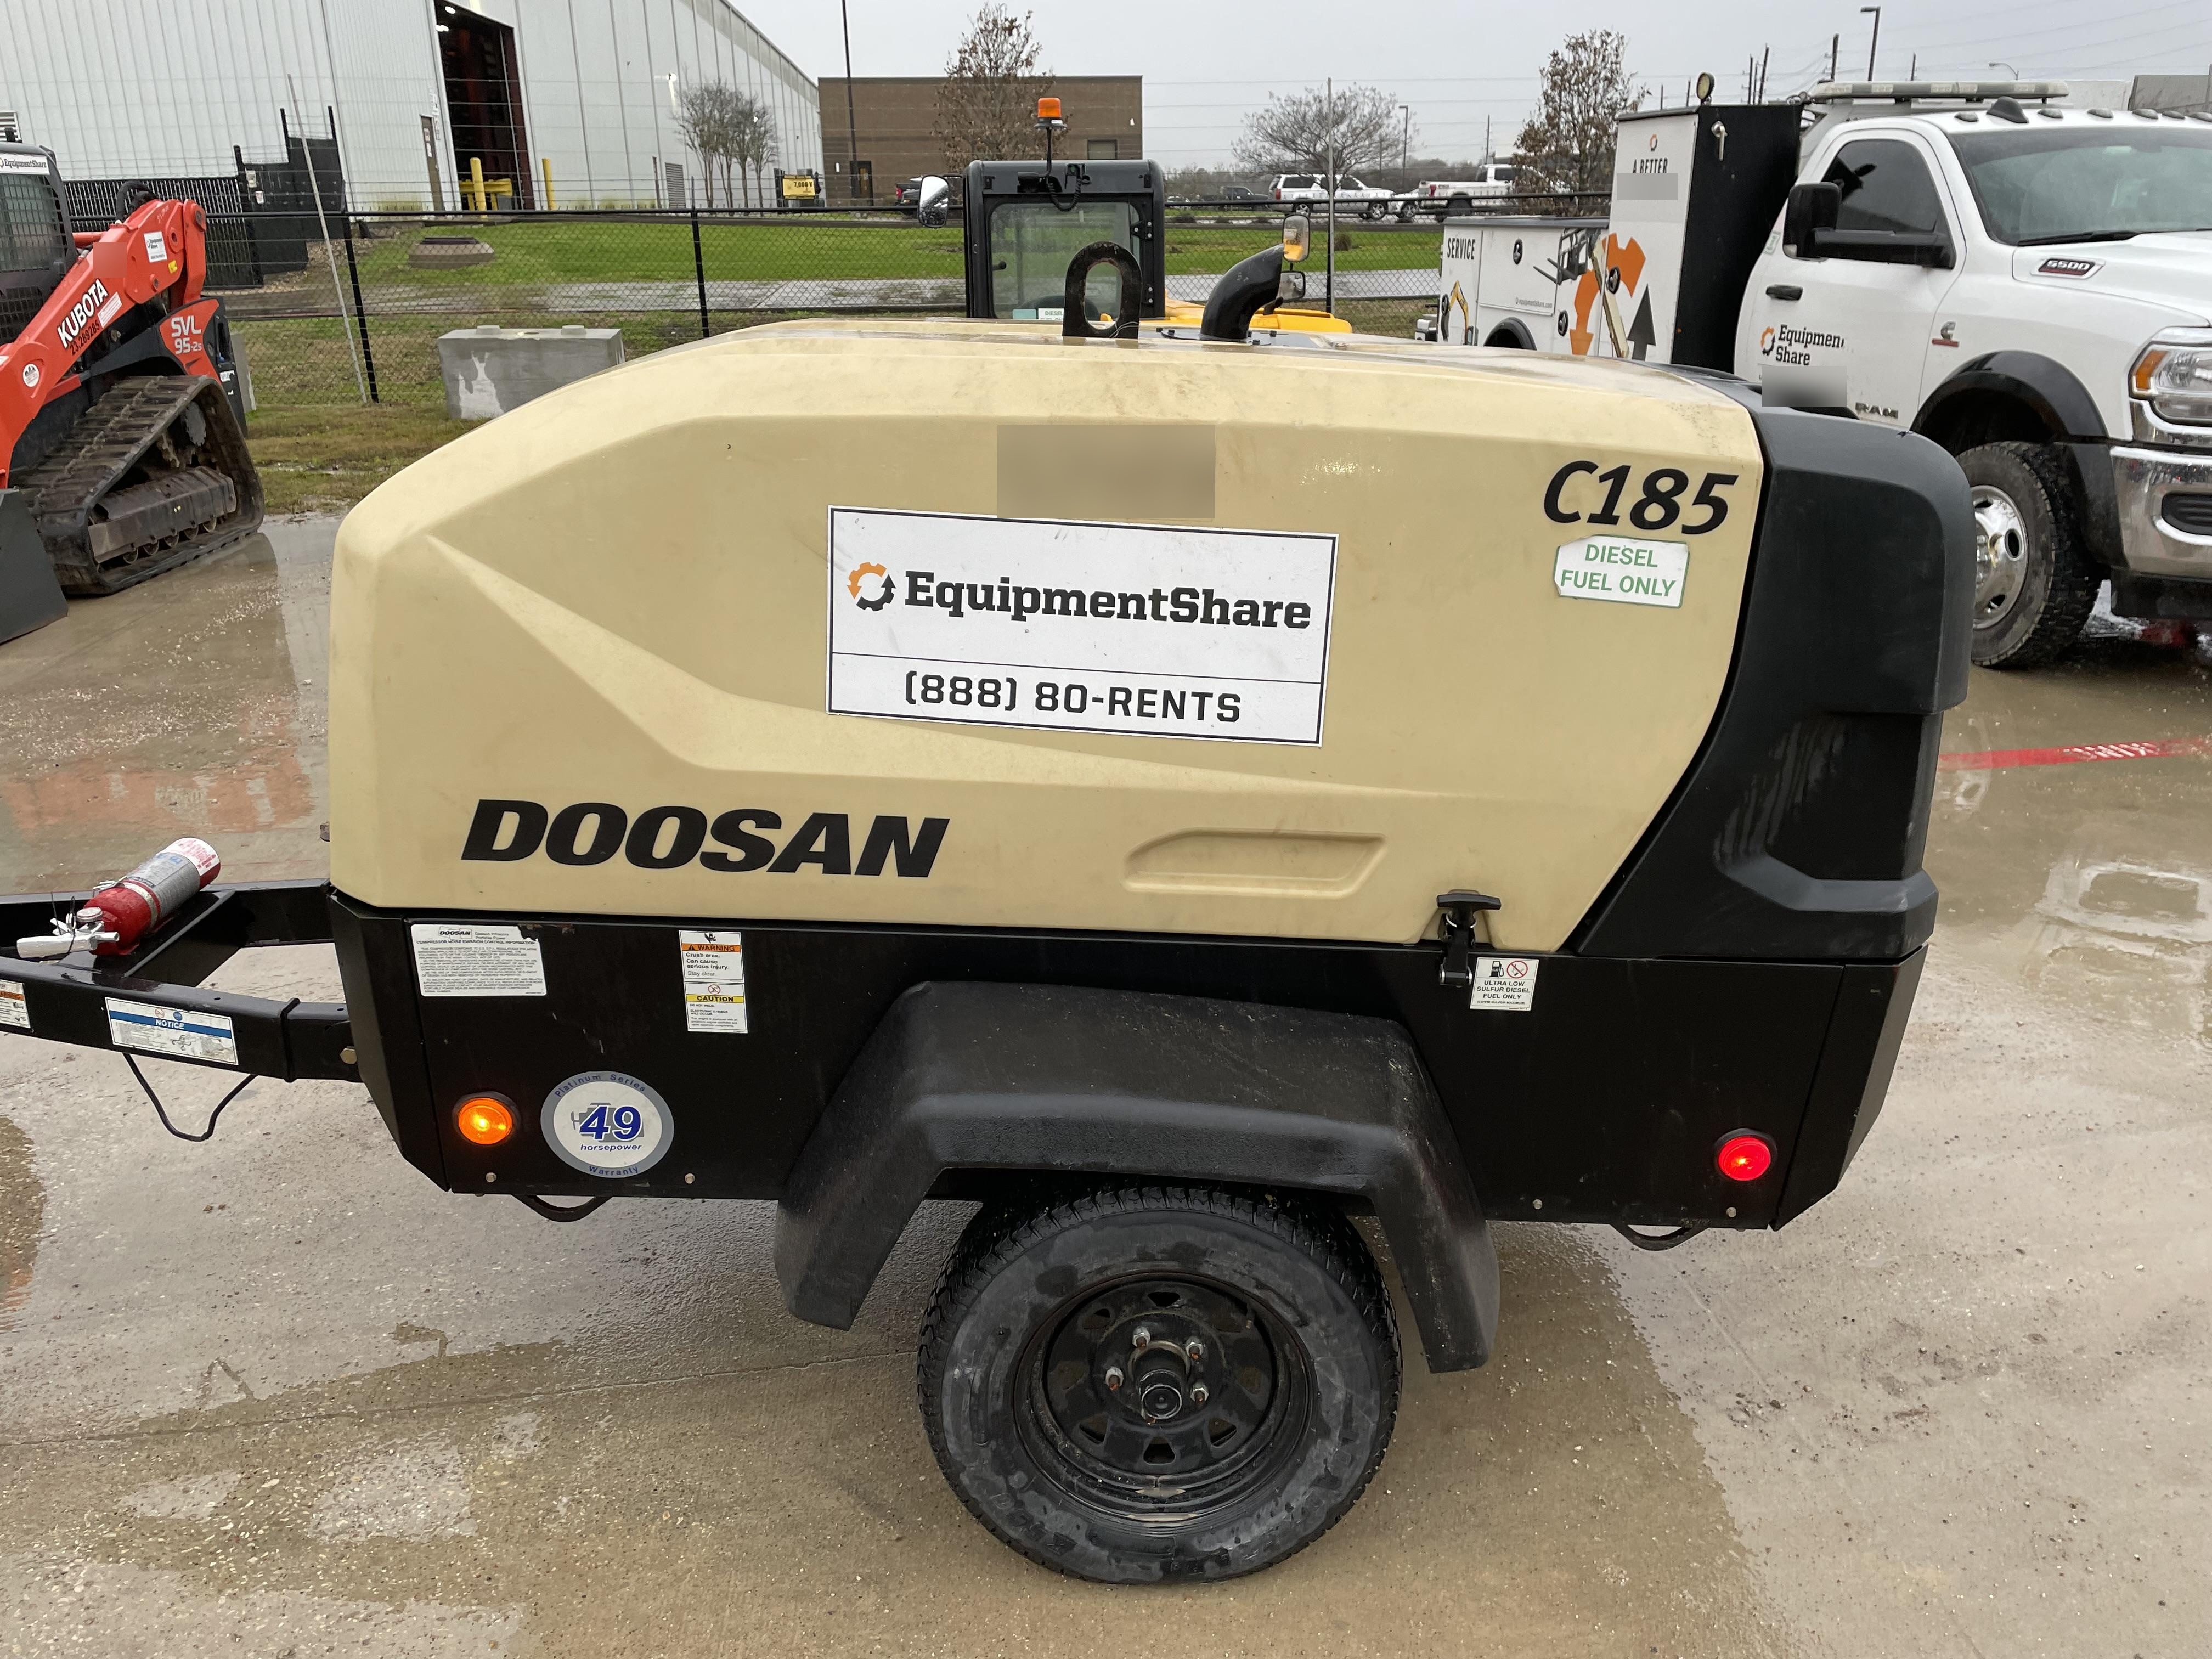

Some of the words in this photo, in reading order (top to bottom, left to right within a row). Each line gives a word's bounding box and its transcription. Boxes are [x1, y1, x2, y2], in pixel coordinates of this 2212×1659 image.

[1640, 158, 1668, 173] BETTER
[1447, 238, 1475, 259] SERVICE
[2047, 260, 2090, 270] 5500
[57, 278, 108, 349] KUBOTA
[171, 315, 201, 337] SVL
[1776, 345, 1810, 365] Share
[1855, 402, 1899, 419] RAM
[1544, 460, 1739, 534] C185
[1585, 544, 1658, 568] DIESEL
[1561, 570, 1612, 591] FUEL
[1620, 575, 1676, 597] ONLY
[905, 571, 1311, 629] EquipmentShare
[906, 671, 1017, 712] (888)
[1035, 682, 1241, 723] 80-RENTS
[461, 799, 950, 878] DOOSAN
[155, 1019, 185, 1030] NOTICE
[554, 1075, 601, 1097] Platinum
[610, 1074, 646, 1092] Series
[579, 1104, 643, 1141] 49
[588, 1165, 639, 1176] Warranty
